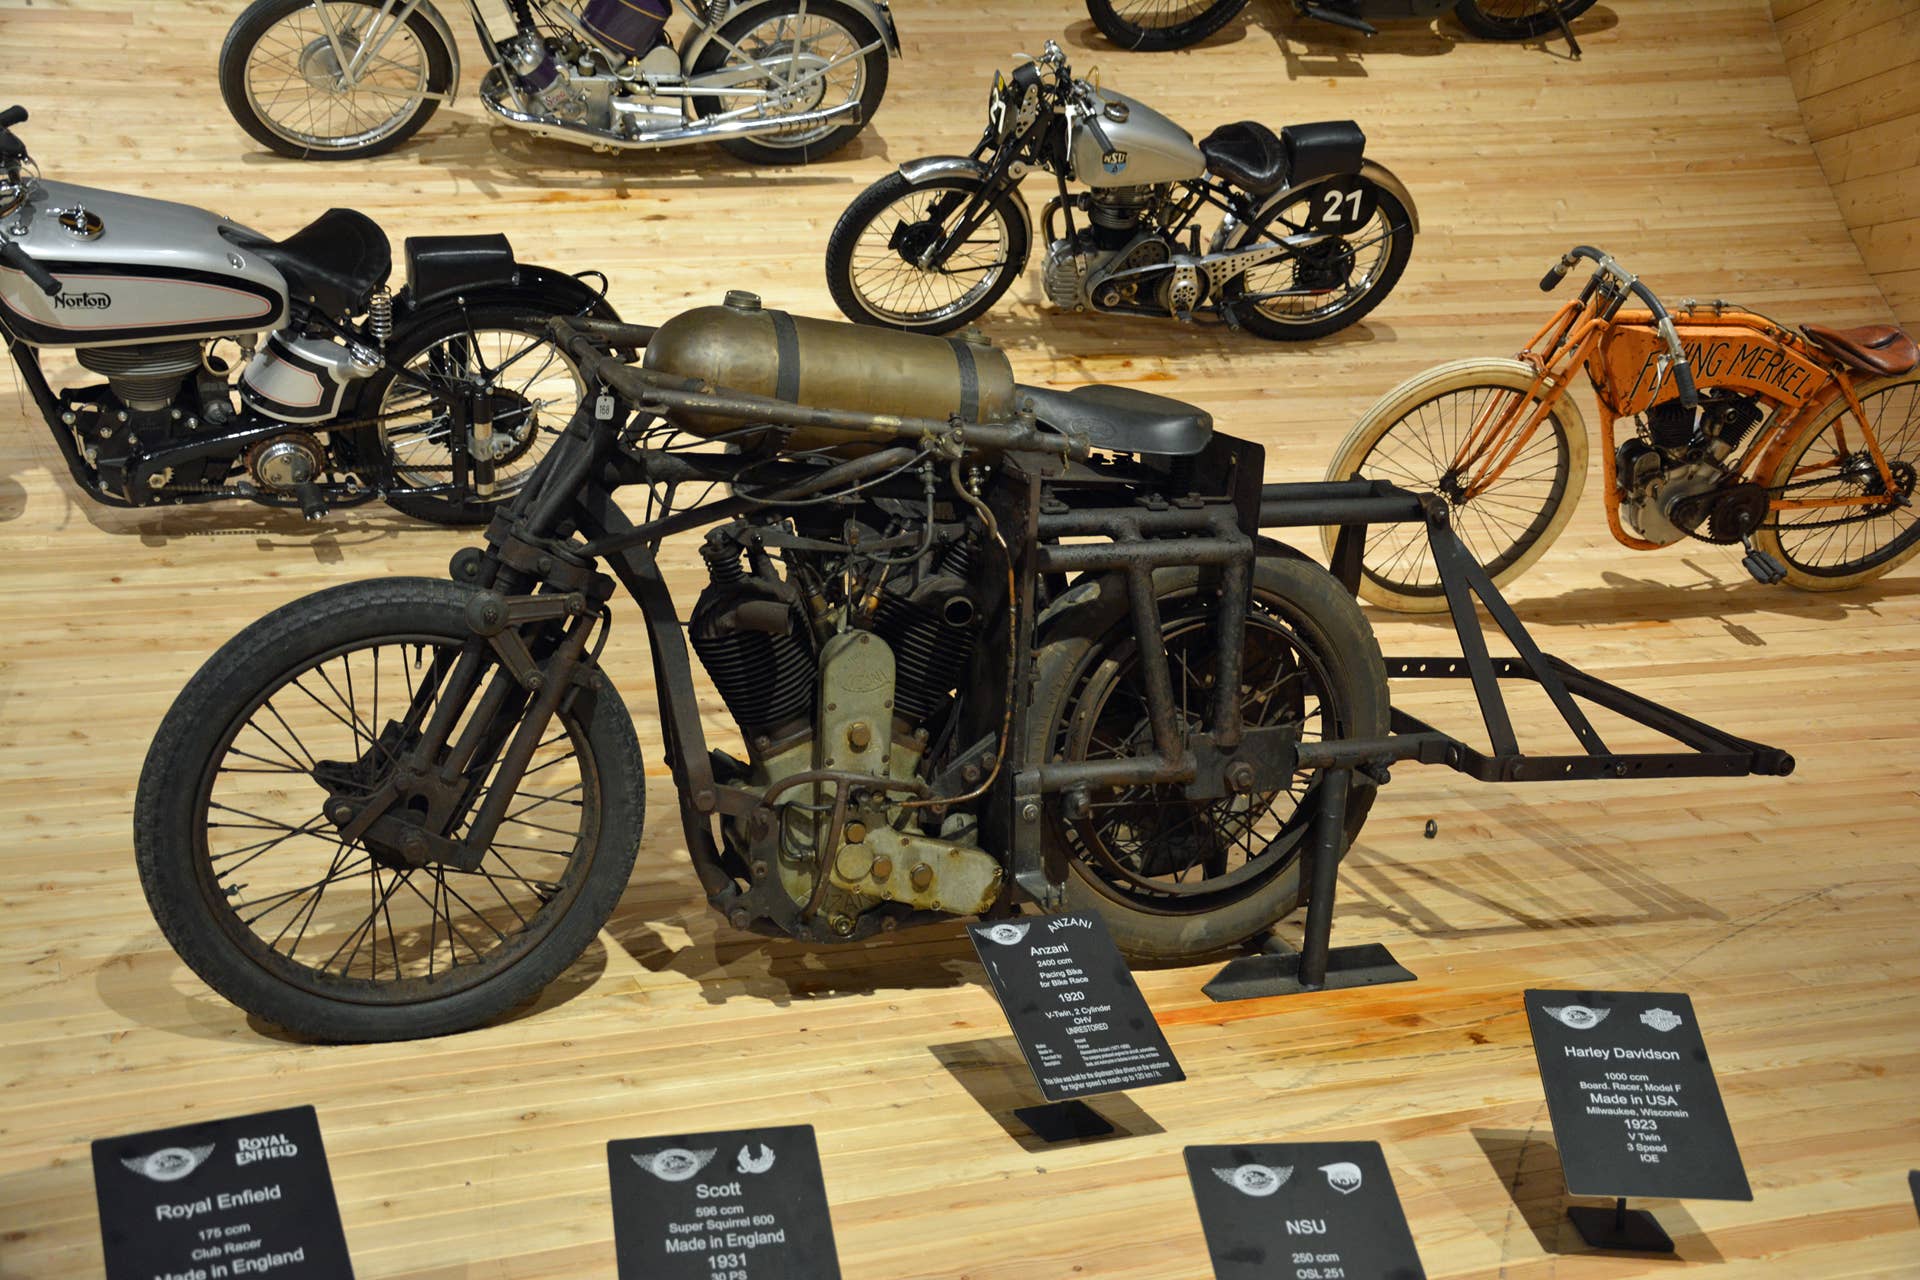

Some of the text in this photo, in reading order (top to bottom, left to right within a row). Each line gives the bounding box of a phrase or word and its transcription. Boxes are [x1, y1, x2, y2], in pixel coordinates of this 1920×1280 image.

[1104, 152, 1126, 164] NSU
[1322, 189, 1362, 222] 21
[54, 292, 111, 309] Norton
[1727, 343, 1812, 399] MERKEL
[1048, 917, 1093, 934] ANZANI
[1030, 942, 1069, 956] Anzani
[1036, 959, 1056, 968] 2400
[1040, 971, 1066, 979] Pacing
[1058, 991, 1085, 1002] 1920
[1081, 1004, 1111, 1015] Cylinder
[1074, 1016, 1092, 1024] OHV
[1066, 1022, 1108, 1035] UNRESTORED
[1564, 1046, 1680, 1061] Harley Davidson
[1604, 1072, 1627, 1080] 1000
[1644, 1083, 1673, 1092] Model
[1674, 1084, 1682, 1092] F
[1590, 1093, 1678, 1106] Made in USA
[1586, 1106, 1688, 1118] Milwaukee, Wisconsin
[1624, 1118, 1658, 1130] 1923
[238, 1134, 290, 1151] ROYAL
[1628, 1132, 1660, 1142] V Twin
[1627, 1142, 1668, 1153] 3 Speed
[235, 1144, 298, 1166] ENFIELD
[1640, 1154, 1660, 1163] IOE
[696, 1182, 742, 1199] Scott
[155, 1185, 282, 1221] Royal Enfield
[696, 1205, 744, 1218] 596 ccm
[669, 1214, 774, 1234] Super Squirrel 600
[1286, 1220, 1326, 1235] NSU
[198, 1224, 251, 1241] 175 ccm
[665, 1229, 785, 1254] Made in England
[191, 1238, 262, 1260] Club Racer
[210, 1264, 228, 1278] in
[232, 1247, 305, 1274] England
[708, 1252, 746, 1269] 1931
[1292, 1252, 1340, 1264] 250 ccm
[729, 1270, 748, 1280] PS
[1296, 1268, 1344, 1280] OSL 251
